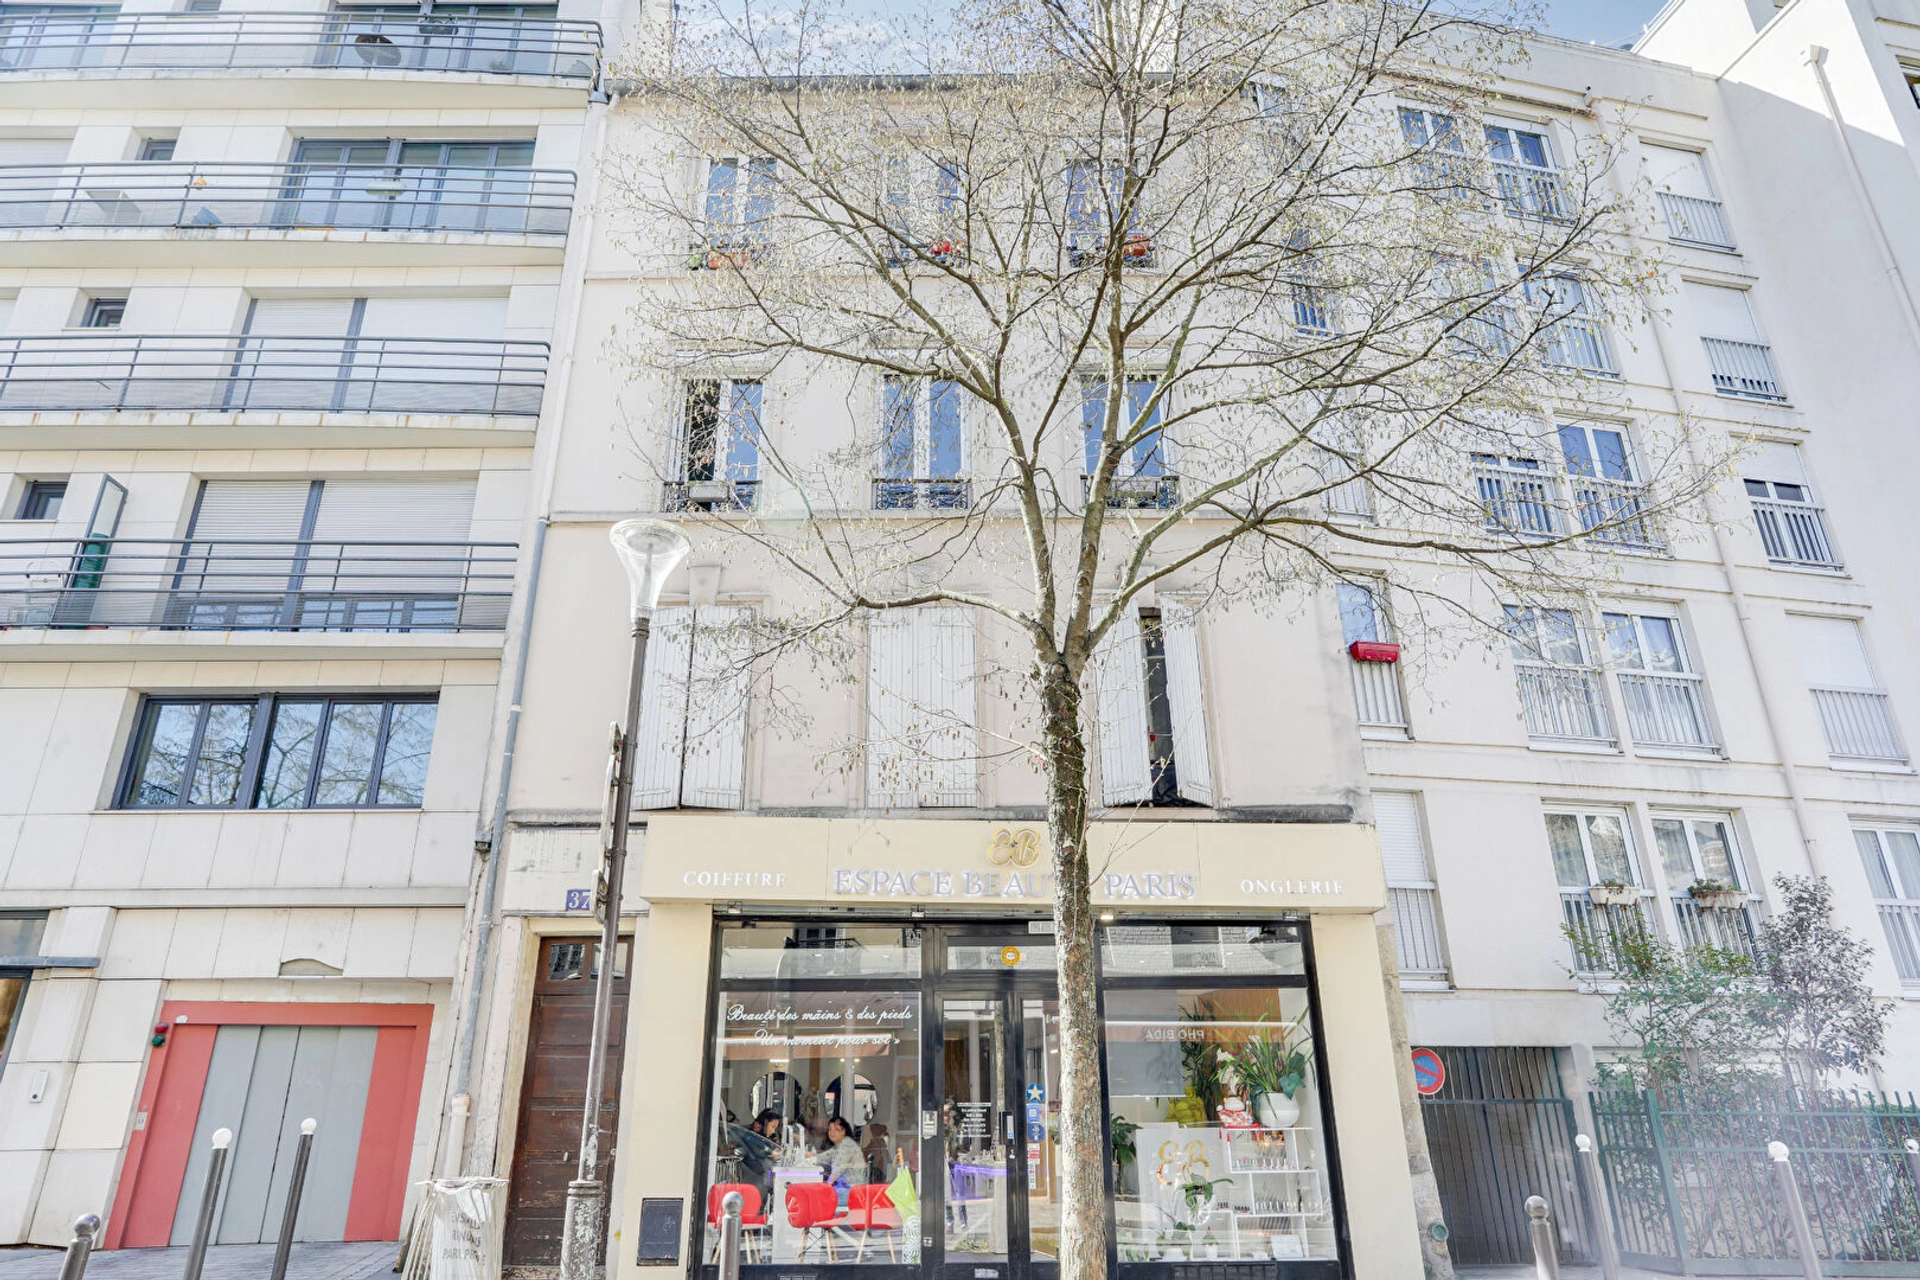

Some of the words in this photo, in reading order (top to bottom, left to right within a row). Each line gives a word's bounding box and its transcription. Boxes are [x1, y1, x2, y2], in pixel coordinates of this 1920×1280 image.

[683, 871, 786, 887] COIFFURE
[834, 868, 954, 895] ESPACE
[962, 871, 1094, 897] BEAU
[1104, 873, 1196, 899] PARIS
[1240, 879, 1344, 894] ONGLERIE
[568, 891, 591, 909] 37
[726, 1003, 777, 1021] Beauté
[778, 1006, 799, 1021] des
[844, 1008, 854, 1020] &
[856, 1005, 877, 1021] des
[876, 1005, 912, 1025] pieds
